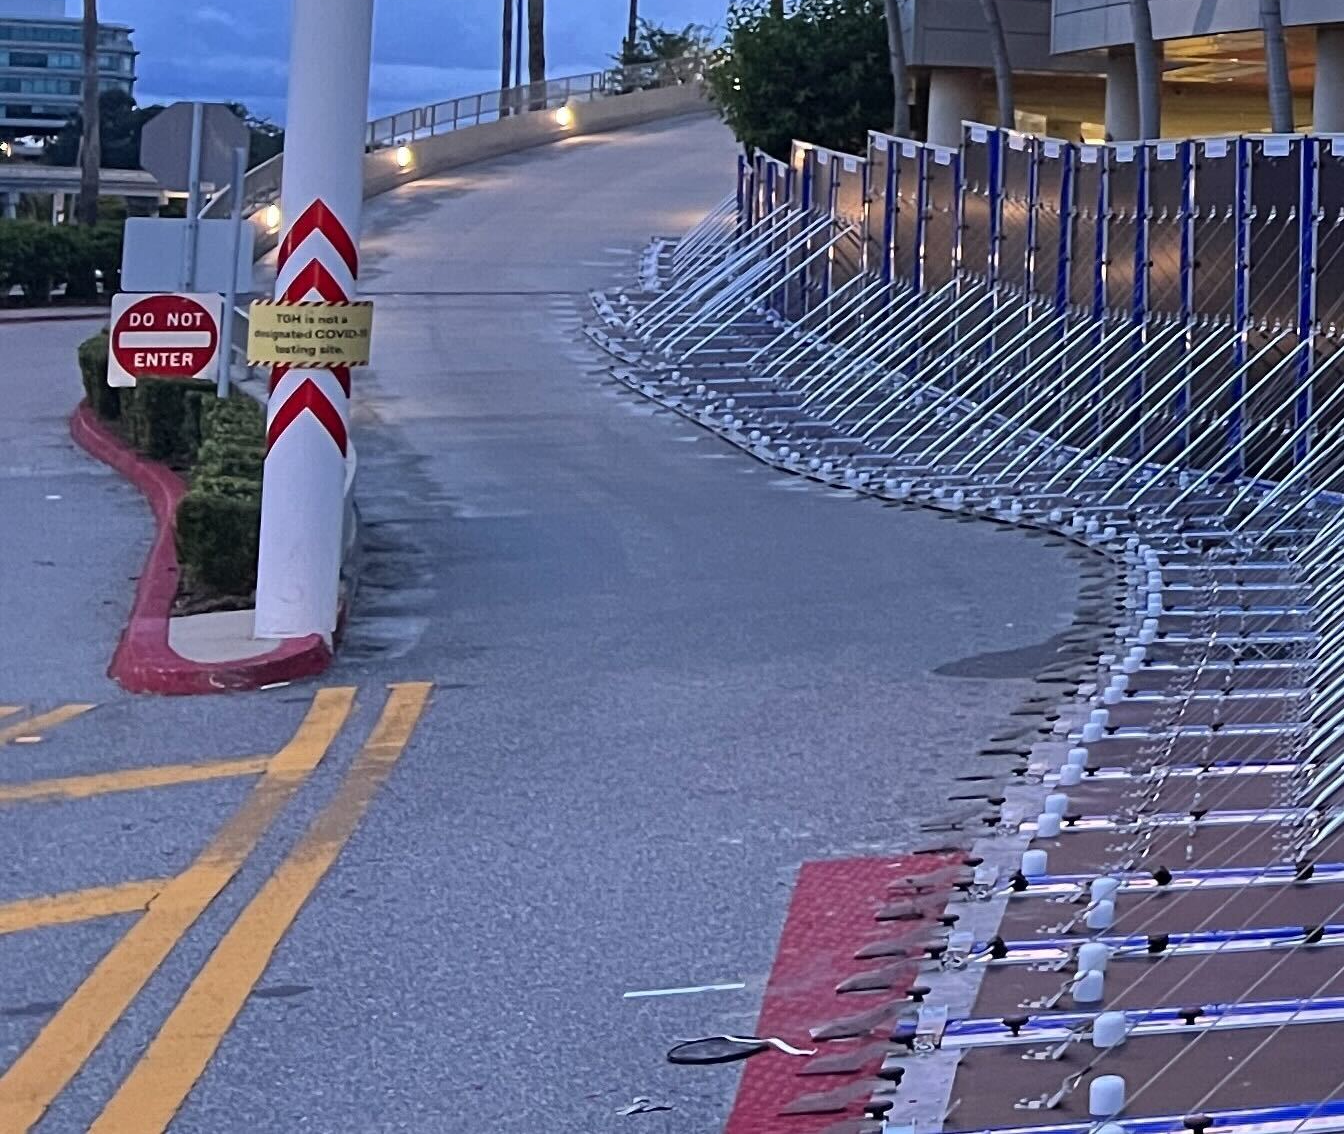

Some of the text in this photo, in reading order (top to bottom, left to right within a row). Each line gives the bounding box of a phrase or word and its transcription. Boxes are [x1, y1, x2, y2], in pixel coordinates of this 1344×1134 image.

[129, 312, 204, 327] DO NOT
[276, 313, 301, 324] TGH
[304, 314, 315, 324] is
[318, 315, 338, 324] not
[134, 352, 194, 368] ENTER
